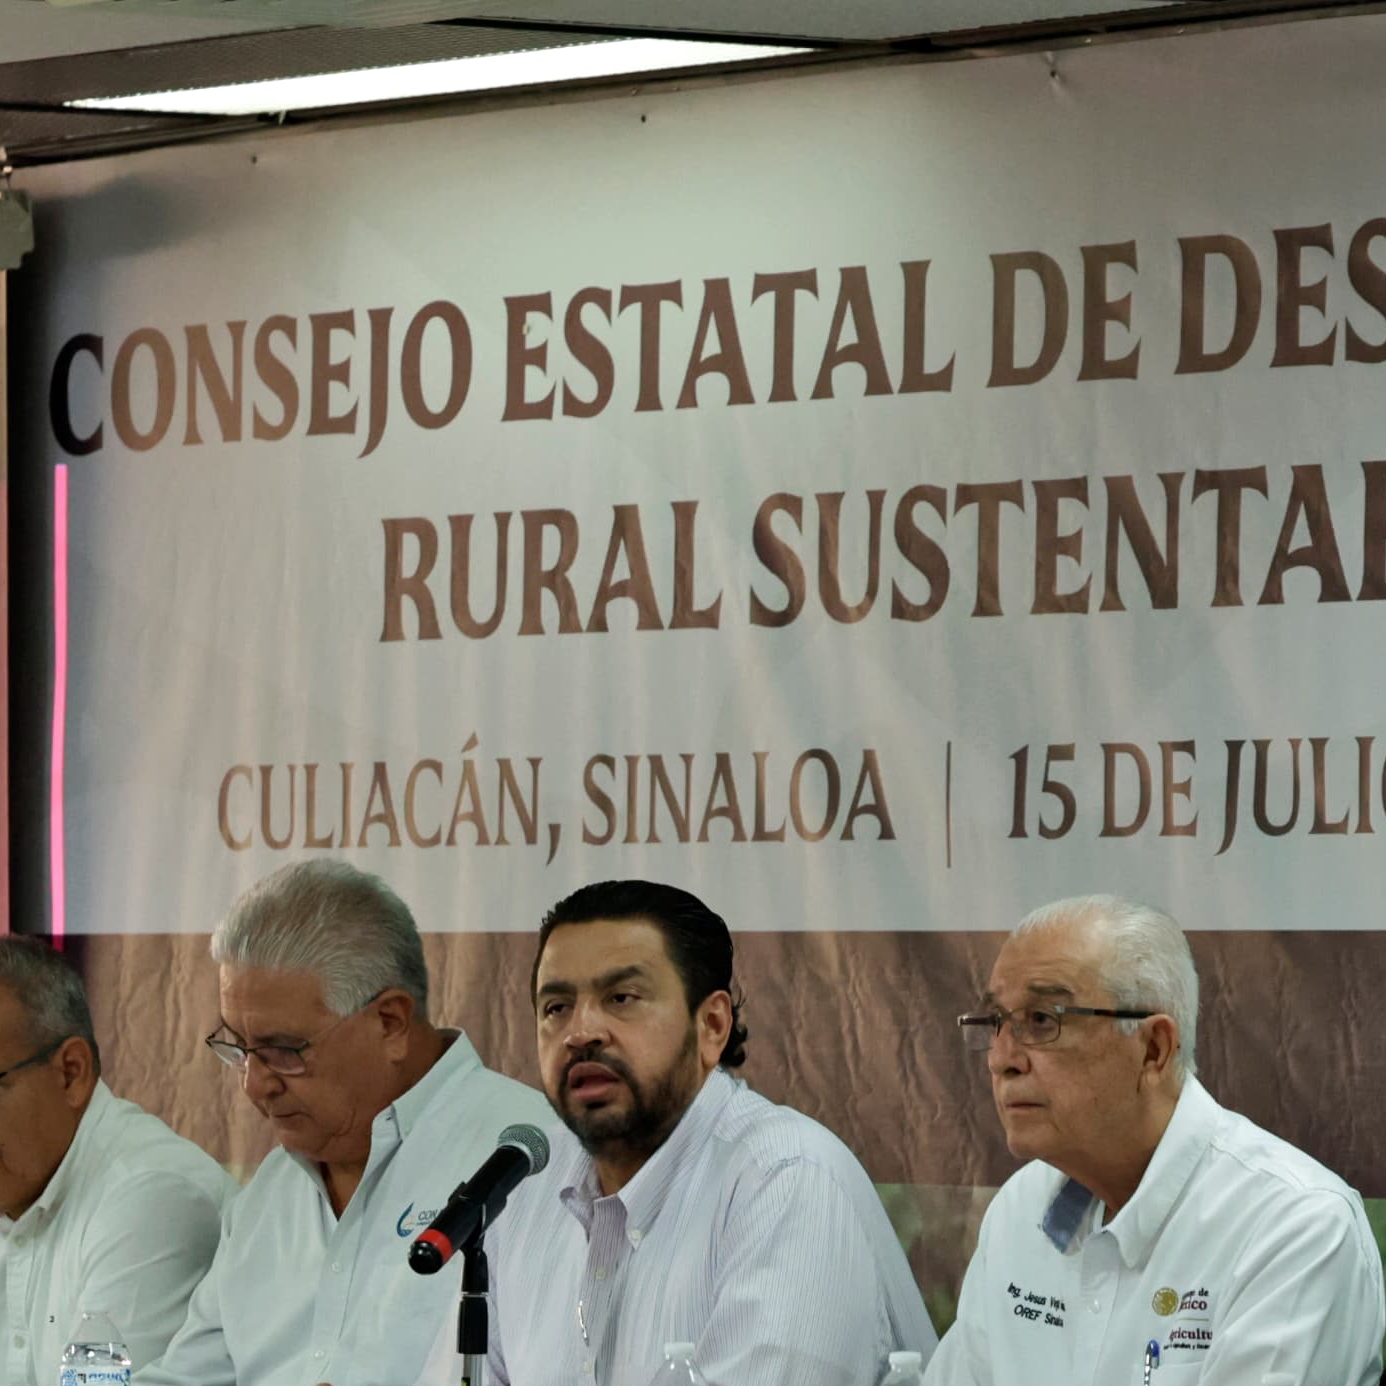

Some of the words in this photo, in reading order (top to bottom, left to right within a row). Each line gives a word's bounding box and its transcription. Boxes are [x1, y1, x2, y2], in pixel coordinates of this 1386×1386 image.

[49, 300, 473, 459] CONSEJO
[501, 258, 956, 422] ESTATAL
[985, 238, 1142, 389] DE
[378, 500, 723, 643] RURAL
[216, 731, 562, 867] CULIACÁN,
[581, 747, 897, 848] SINALOA
[1007, 741, 1077, 840] 15
[1098, 738, 1199, 838] DE
[1013, 1303, 1043, 1321] OREF
